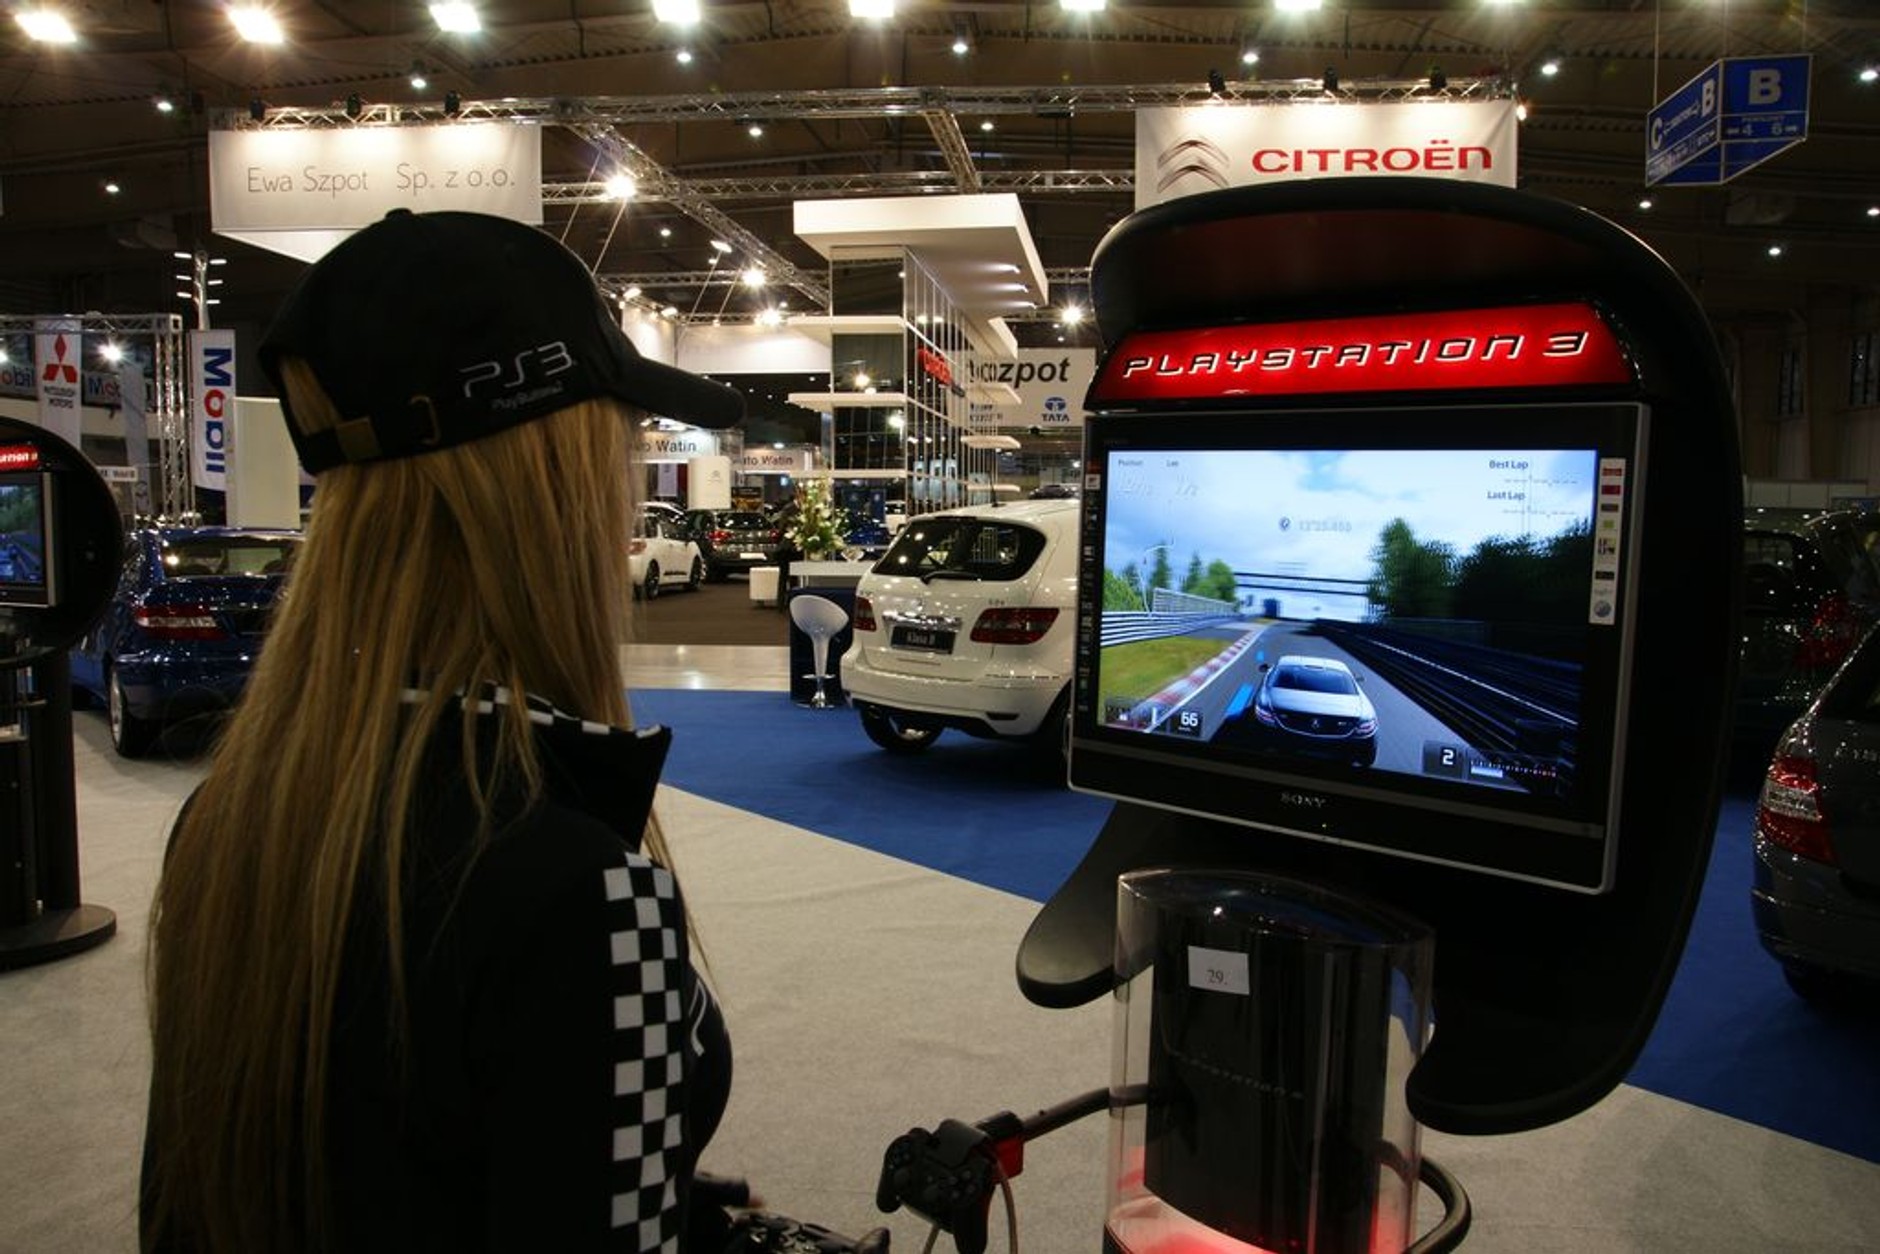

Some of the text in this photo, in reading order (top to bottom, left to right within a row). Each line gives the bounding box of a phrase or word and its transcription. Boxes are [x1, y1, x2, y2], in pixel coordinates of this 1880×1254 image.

[1702, 78, 1716, 117] B
[1749, 68, 1782, 105] B
[1651, 116, 1664, 150] C
[1251, 139, 1492, 173] CITROËN
[247, 163, 516, 199] Ewa Szpot Sp. z o.o.
[460, 341, 573, 398] PS3
[1122, 331, 1589, 378] PLAYSTATION 3
[203, 348, 233, 473] Mobil
[1041, 413, 1070, 422] TATA
[656, 440, 697, 453] Watin
[762, 455, 794, 466] Watin
[1489, 460, 1529, 470] Best Lap
[1487, 491, 1526, 501] Last Lap
[1442, 749, 1454, 765] 2
